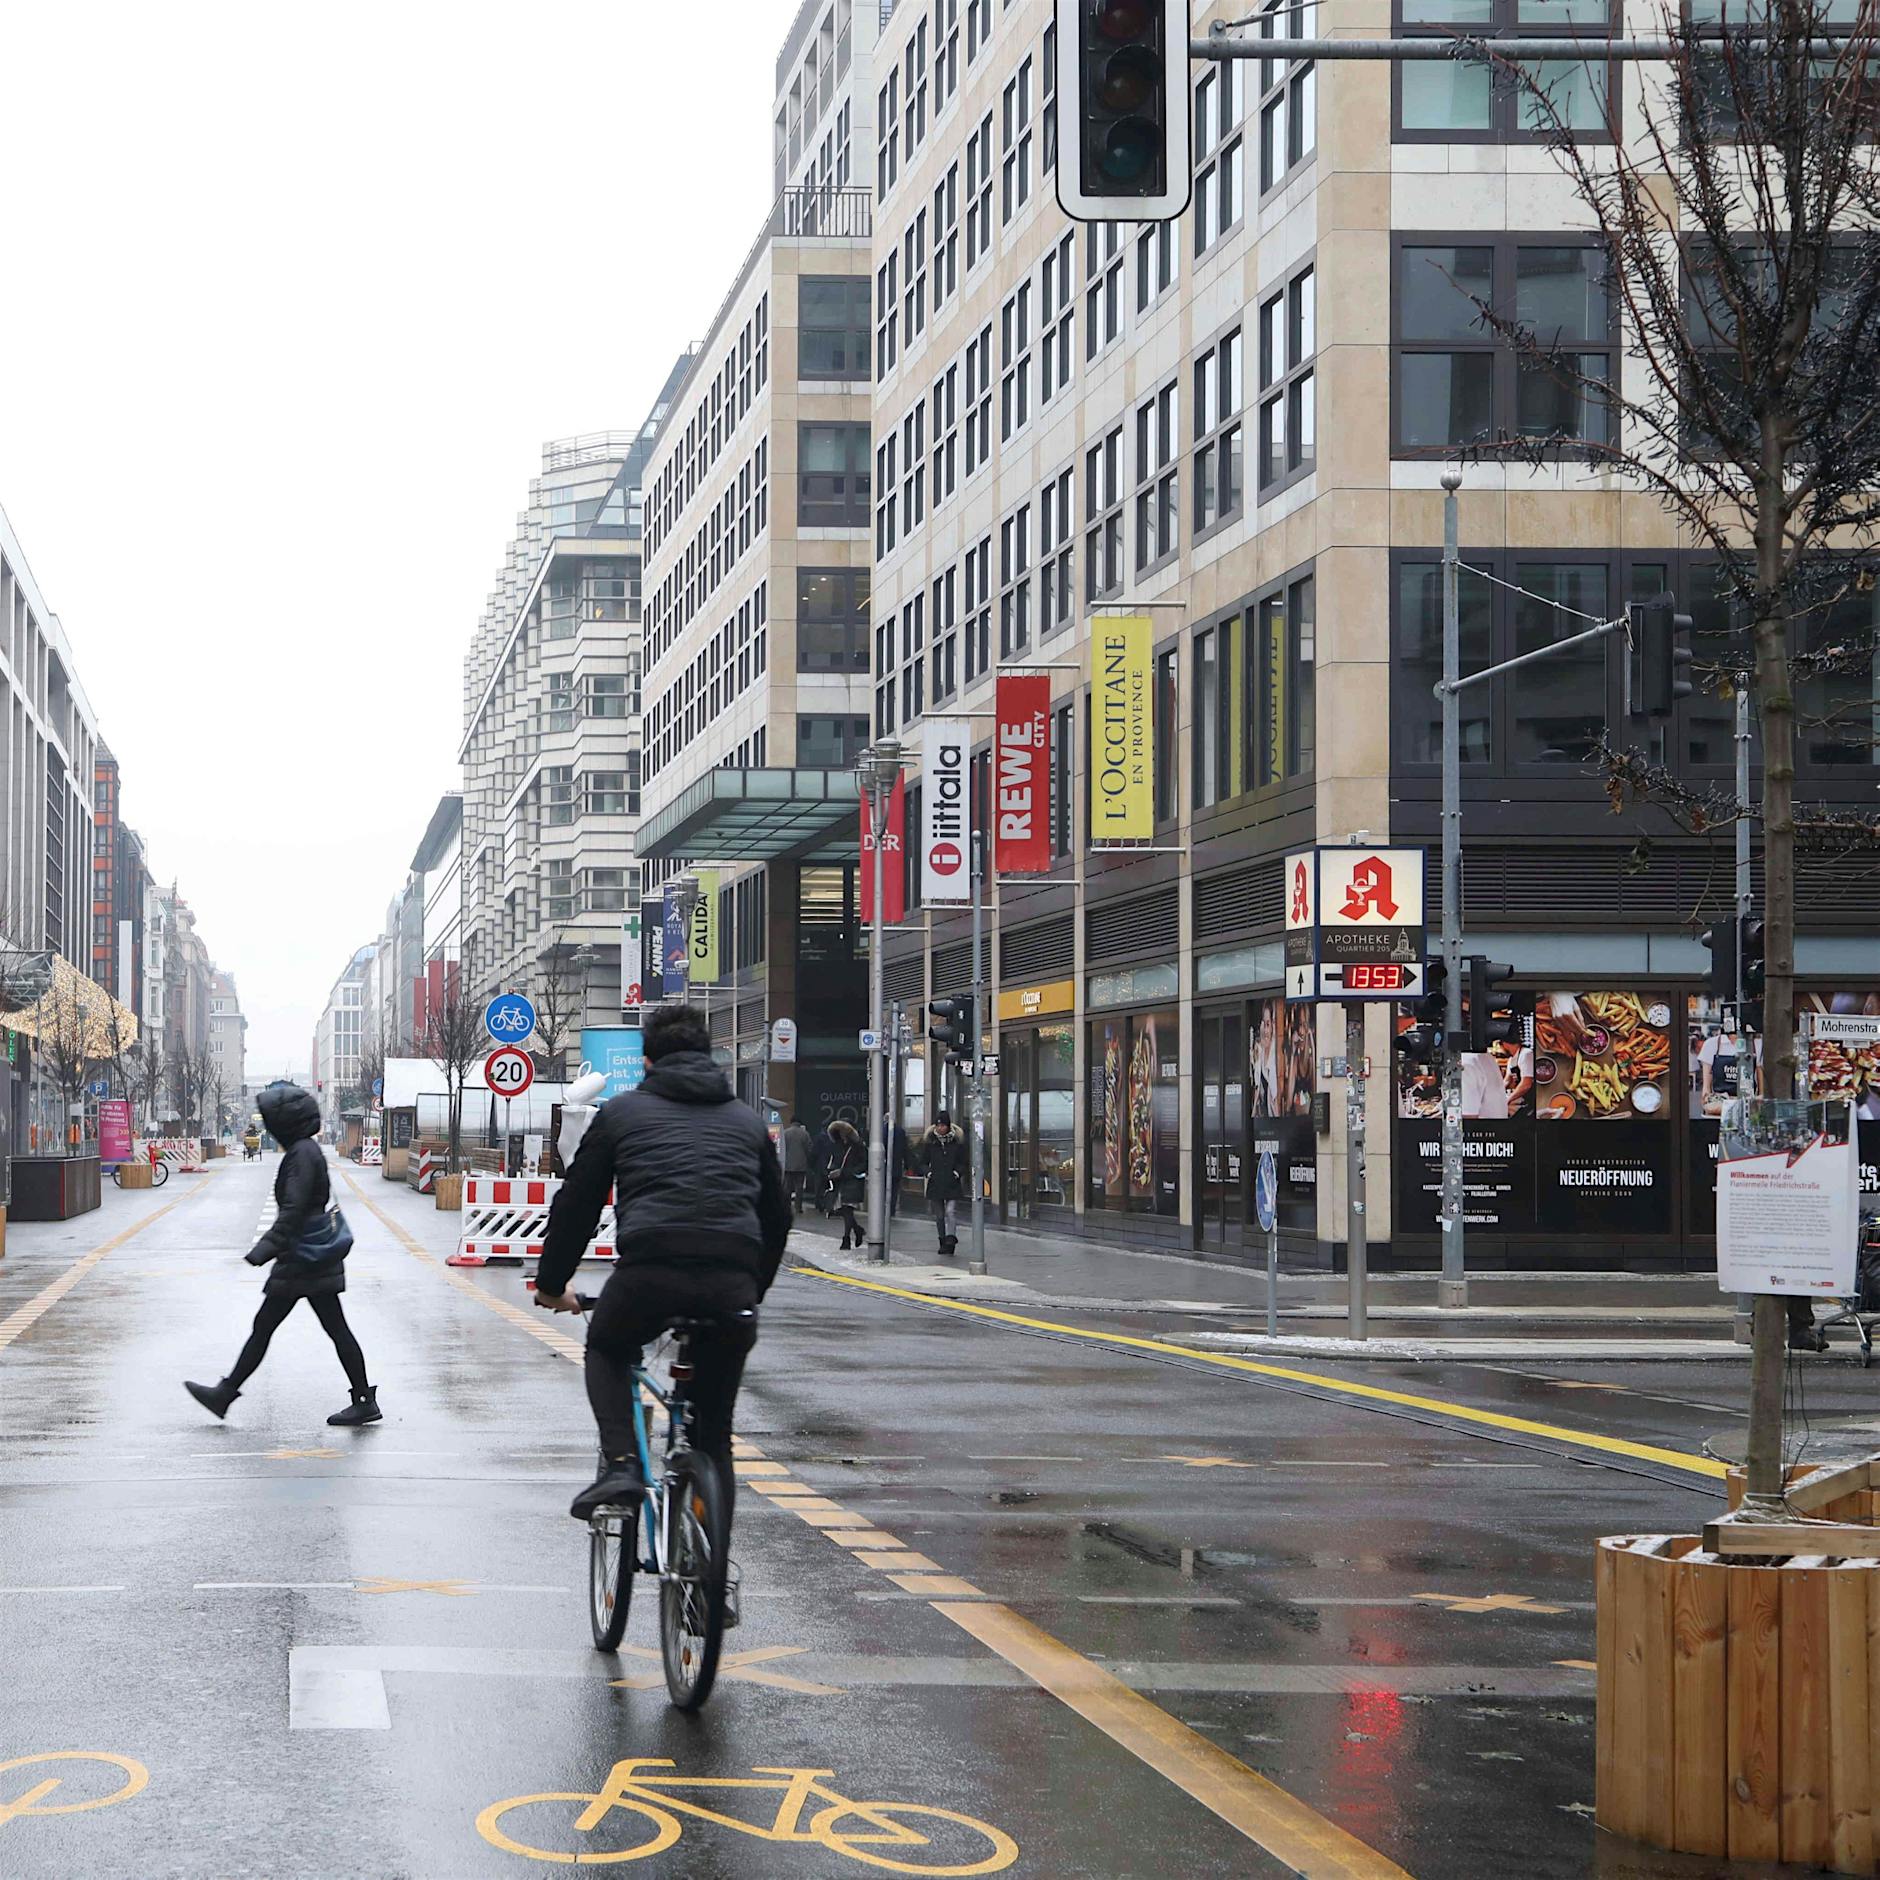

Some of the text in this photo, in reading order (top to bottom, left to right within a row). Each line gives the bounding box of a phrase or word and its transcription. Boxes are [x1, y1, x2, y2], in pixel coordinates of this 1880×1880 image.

[1034, 711, 1045, 748] CITY
[1100, 635, 1127, 820] L'OCCITANE
[1133, 670, 1143, 784] EN PROVENCE
[1000, 721, 1032, 840] REWE
[933, 745, 961, 838] iittala
[695, 895, 708, 958] CALIDA
[1326, 934, 1390, 945] APOTHEKE
[1821, 1021, 1878, 1033] Mohrenstra
[613, 1055, 645, 1065] Entsc
[495, 1062, 522, 1082] 20
[820, 1092, 868, 1101] QUARTIE
[771, 1111, 779, 1122] P
[1419, 1142, 1514, 1157] WIR HEN DICH!
[1560, 1167, 1653, 1186] NEUERÖFFNUNG
[1730, 1171, 1768, 1179] Willkommen
[1770, 1182, 1820, 1190] Friedrichstraße
